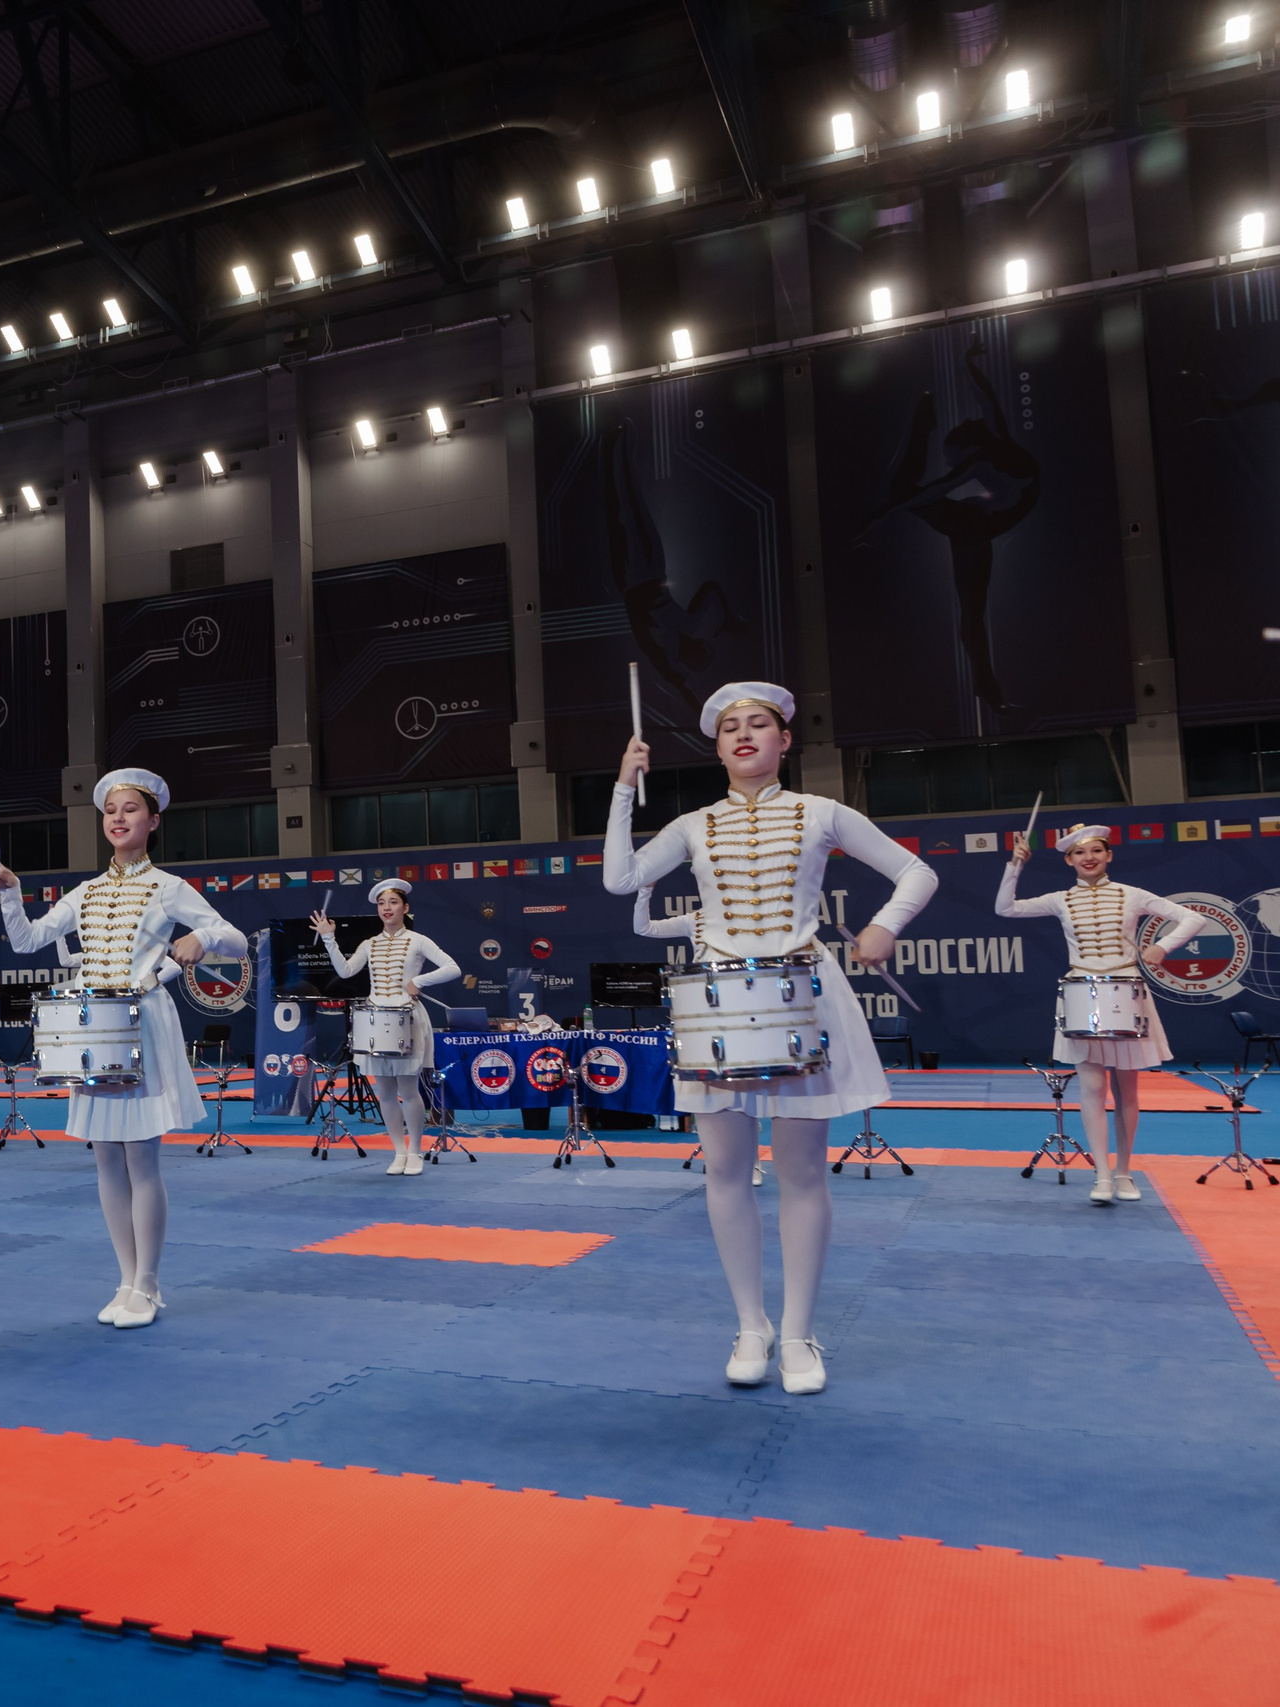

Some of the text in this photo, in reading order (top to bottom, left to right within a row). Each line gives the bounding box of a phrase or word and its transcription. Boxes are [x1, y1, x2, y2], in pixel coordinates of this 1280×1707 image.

[524, 905, 567, 913] МИНСПОРТ
[298, 952, 319, 960] Кабель
[895, 936, 1025, 975] РОССИИ
[1224, 934, 1246, 978] РОССИИ
[235, 963, 249, 997] РОССИИ
[1185, 983, 1207, 991] ГТФ
[518, 993, 536, 1022] 3
[855, 992, 899, 1020] ТФ
[443, 1034, 510, 1046] ФЕДЕРАЦИЯ
[583, 1030, 606, 1041] ГТФ
[609, 1033, 658, 1046] РОССИИ
